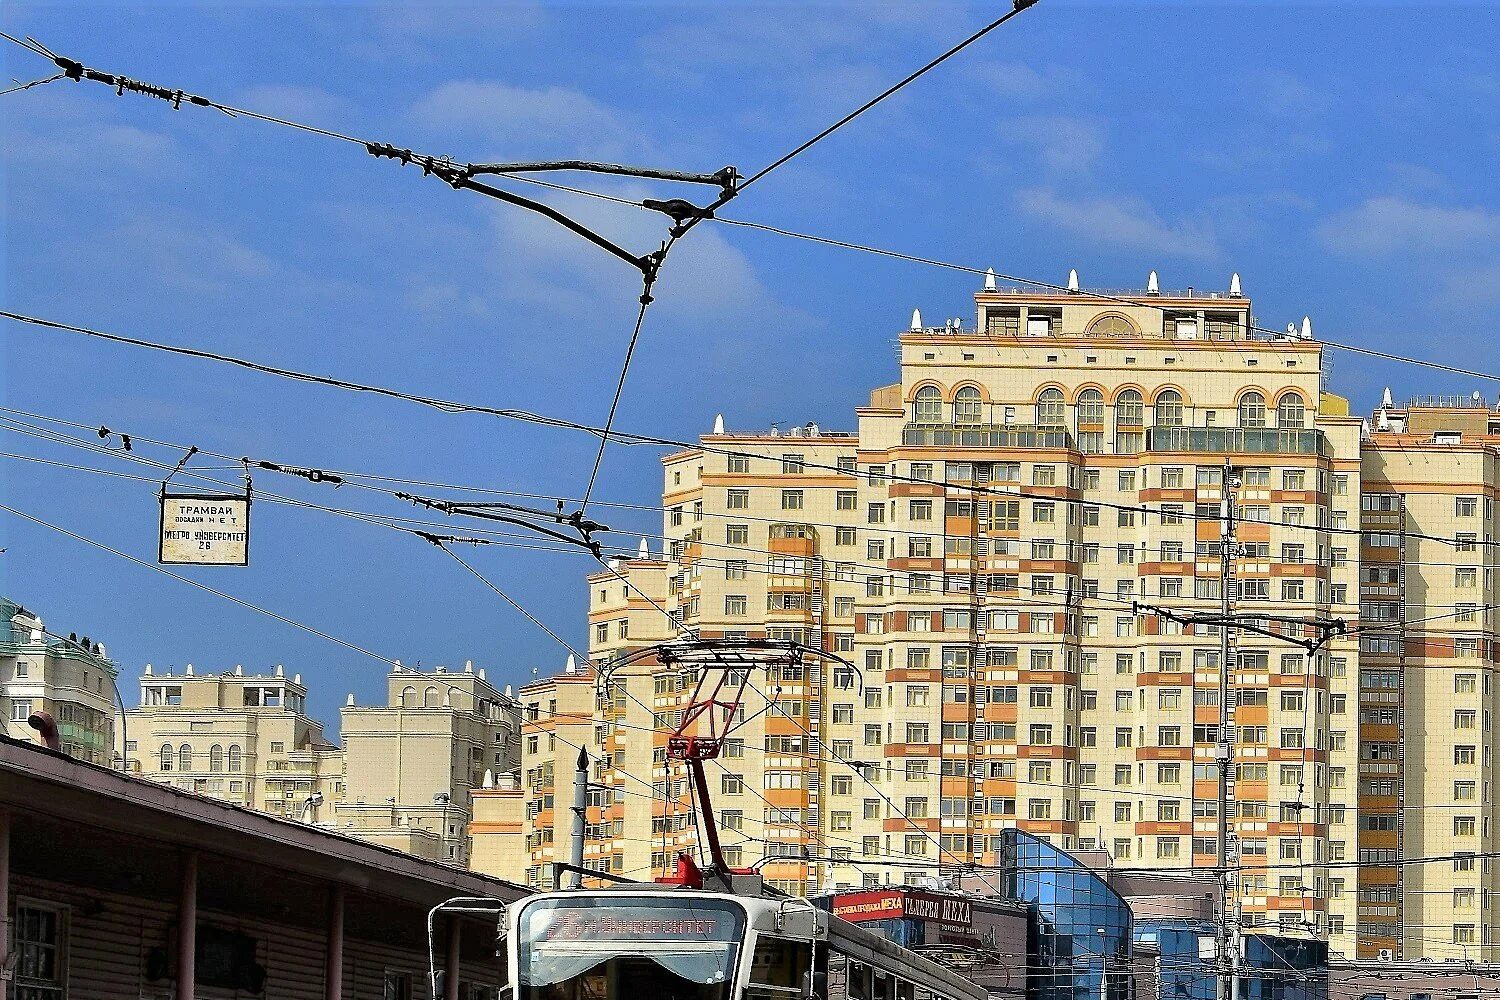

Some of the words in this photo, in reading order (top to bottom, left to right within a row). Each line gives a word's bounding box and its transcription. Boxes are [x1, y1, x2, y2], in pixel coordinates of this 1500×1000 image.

[164, 530, 190, 540] МЕТРО
[881, 897, 902, 910] МЕХА
[904, 897, 939, 919] ГАЛЕРЕЯ
[942, 899, 971, 923] МЕХА
